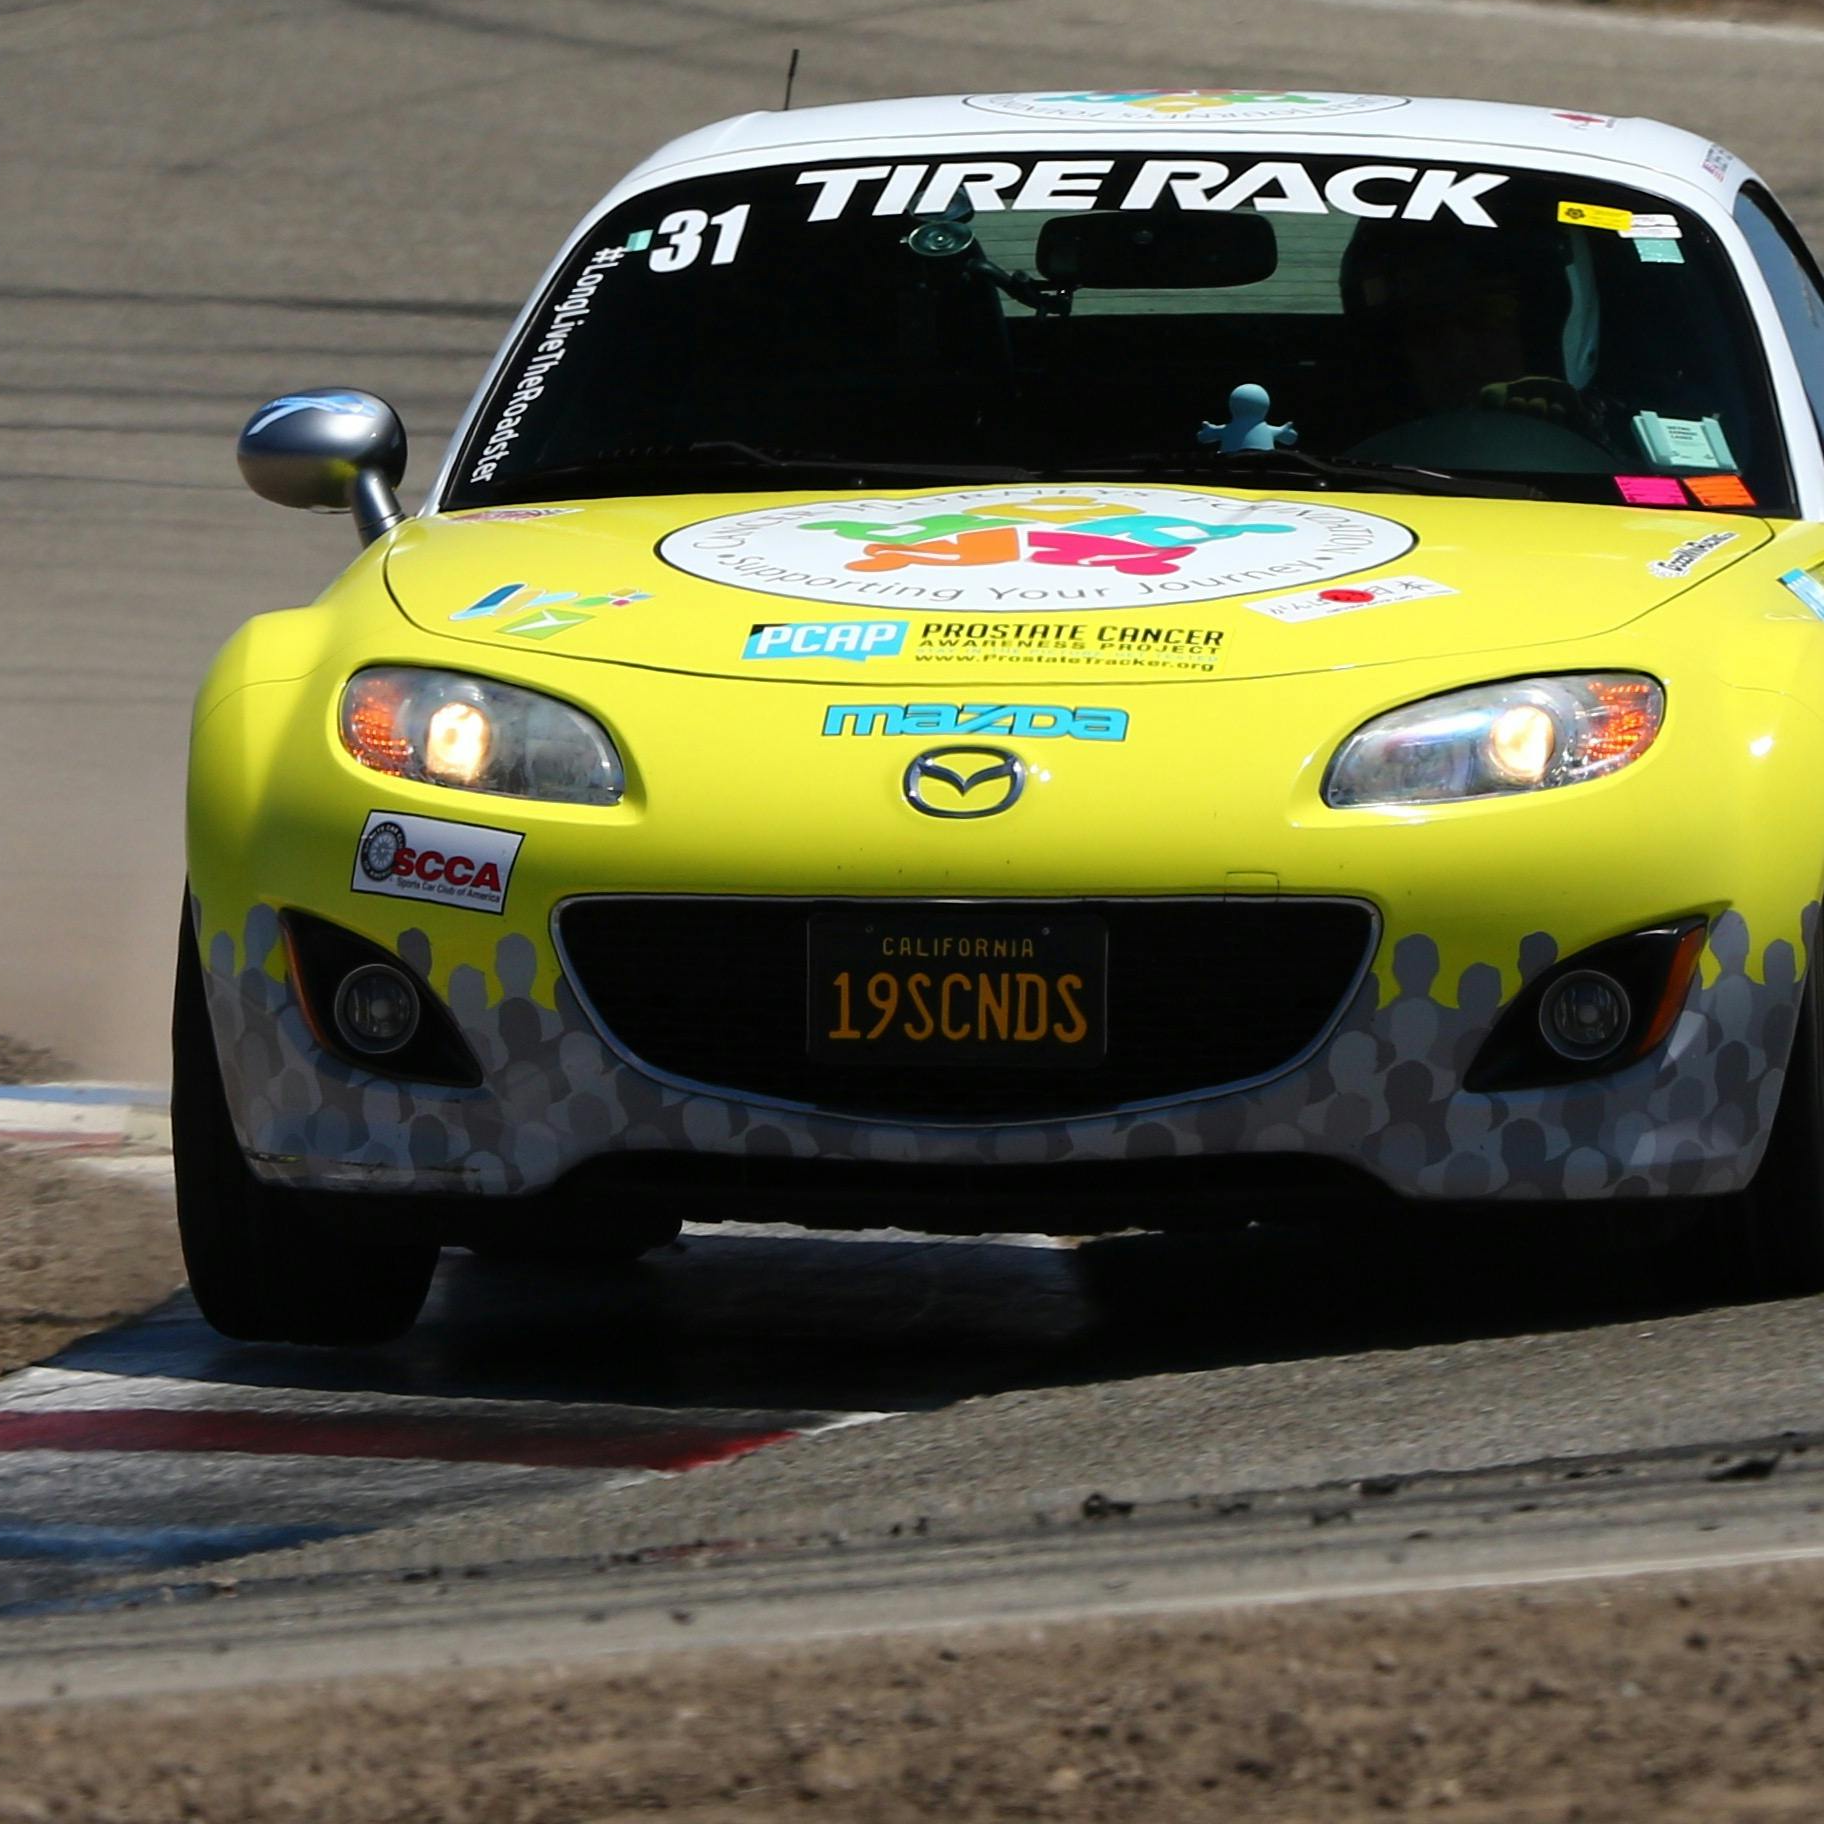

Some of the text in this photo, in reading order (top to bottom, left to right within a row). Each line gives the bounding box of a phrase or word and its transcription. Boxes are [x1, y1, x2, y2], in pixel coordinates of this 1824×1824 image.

[794, 159, 1511, 229] TIRE RACK
[648, 204, 752, 273] 31
[470, 245, 628, 484] #LongLiveTheRoadster
[728, 554, 1324, 602] Supporting Your Journey
[756, 623, 899, 654] PCAP
[919, 639, 1221, 655] AWARENESS PROJECT
[921, 623, 1225, 647] PROSTATE CANCER
[915, 654, 1215, 672] www.ProstateTracker.org
[391, 847, 502, 892] SCCA
[422, 881, 435, 891] Car
[437, 884, 455, 896] Club
[466, 888, 501, 904] America
[881, 937, 1035, 958] CALIFORNIA
[829, 972, 1088, 1043] 19SCNDS
